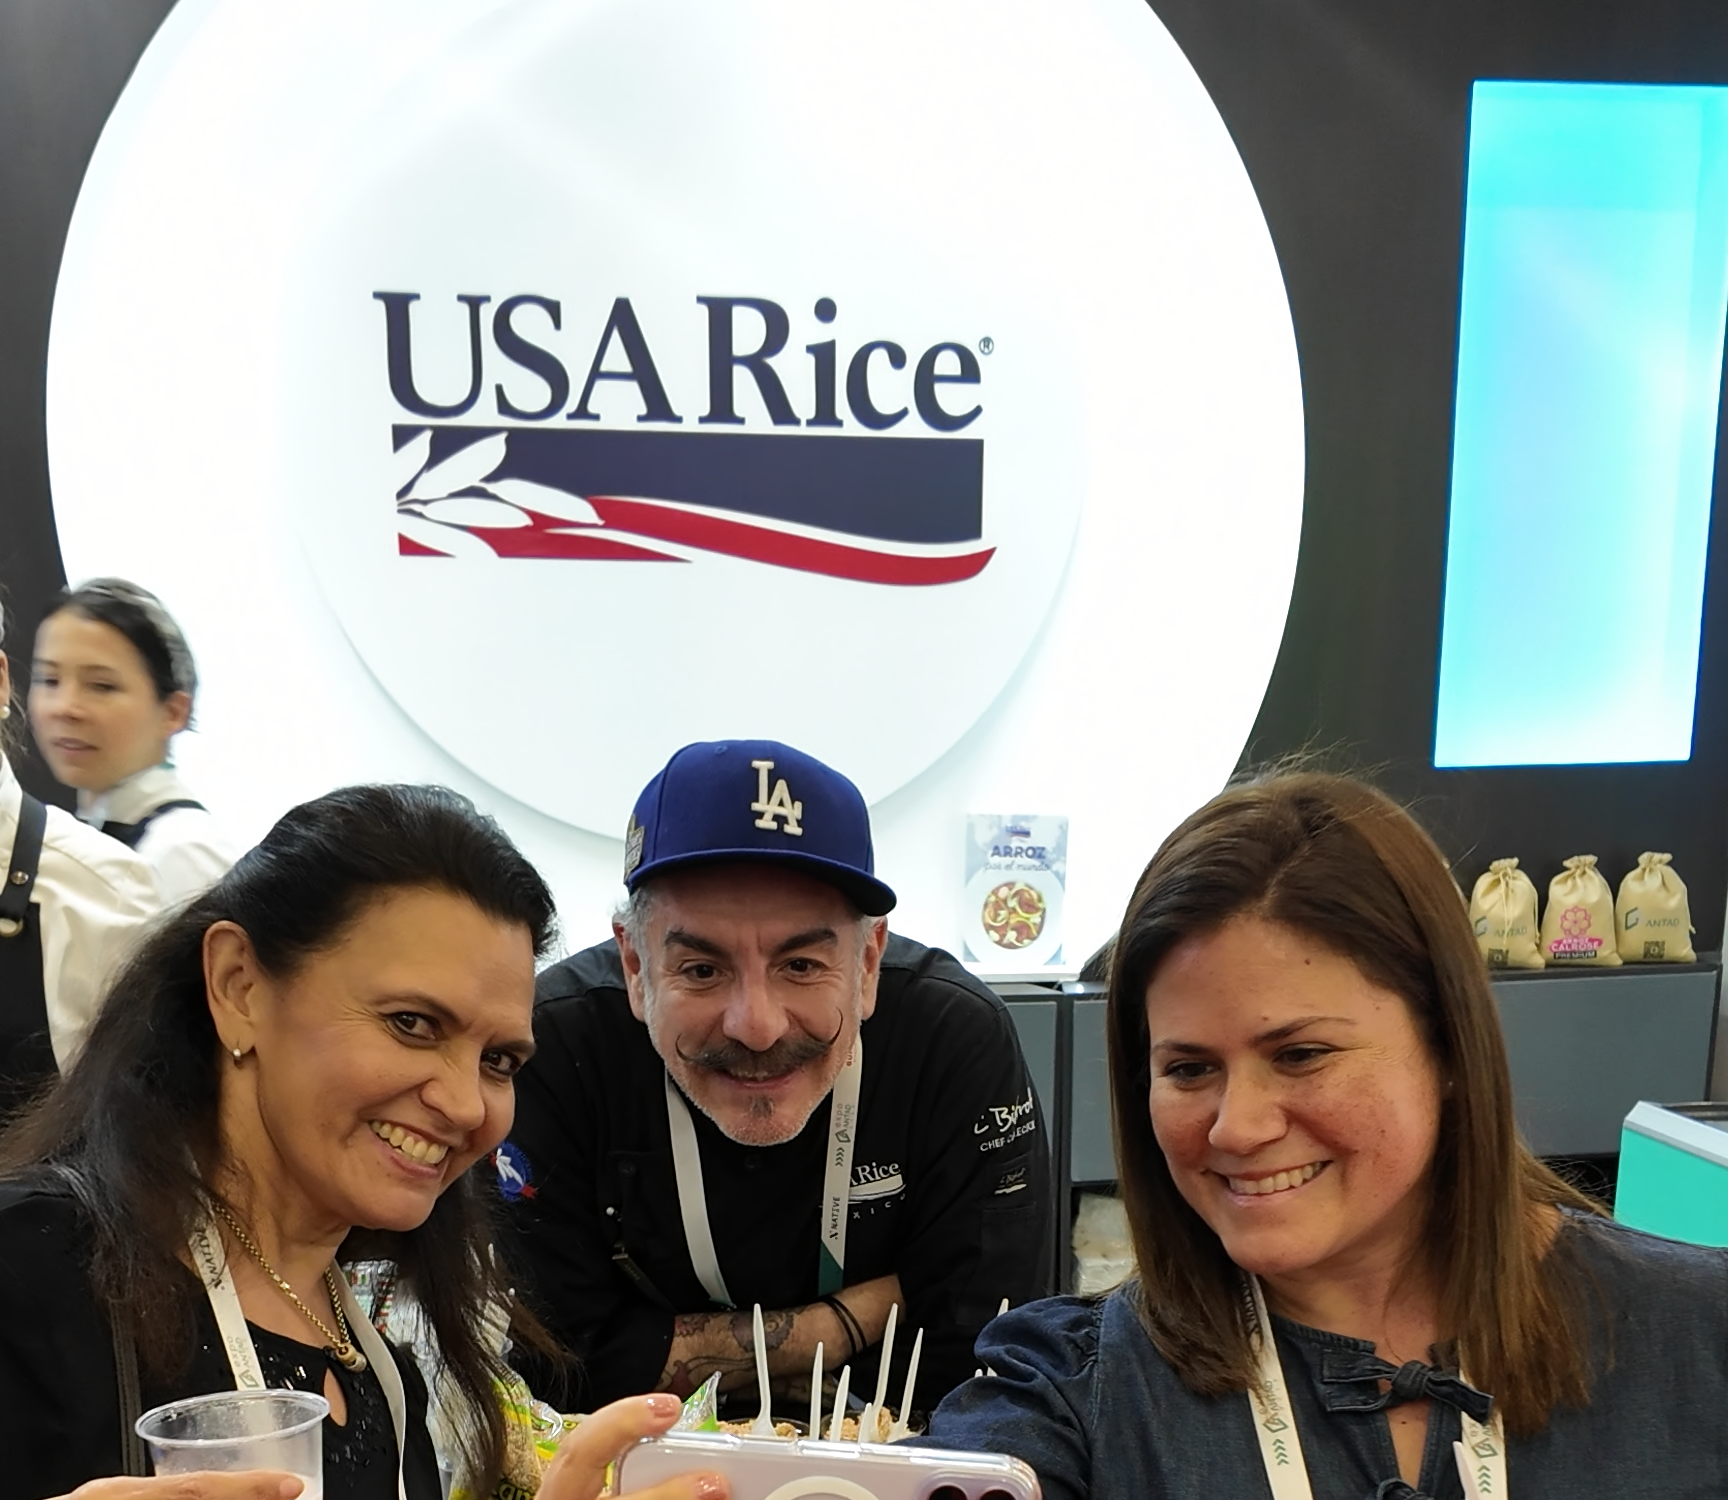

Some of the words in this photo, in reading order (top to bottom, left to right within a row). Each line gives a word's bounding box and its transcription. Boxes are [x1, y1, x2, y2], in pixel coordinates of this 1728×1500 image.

[373, 291, 683, 421] USA
[697, 296, 983, 432] Rice
[751, 760, 803, 836] LA
[990, 845, 1046, 860] ARROZ
[1645, 917, 1680, 928] ANTAD
[1551, 940, 1599, 952] CALROSE
[1555, 951, 1595, 959] PREMIUM
[980, 1137, 1005, 1151] CHEF
[855, 1162, 900, 1184] Rice
